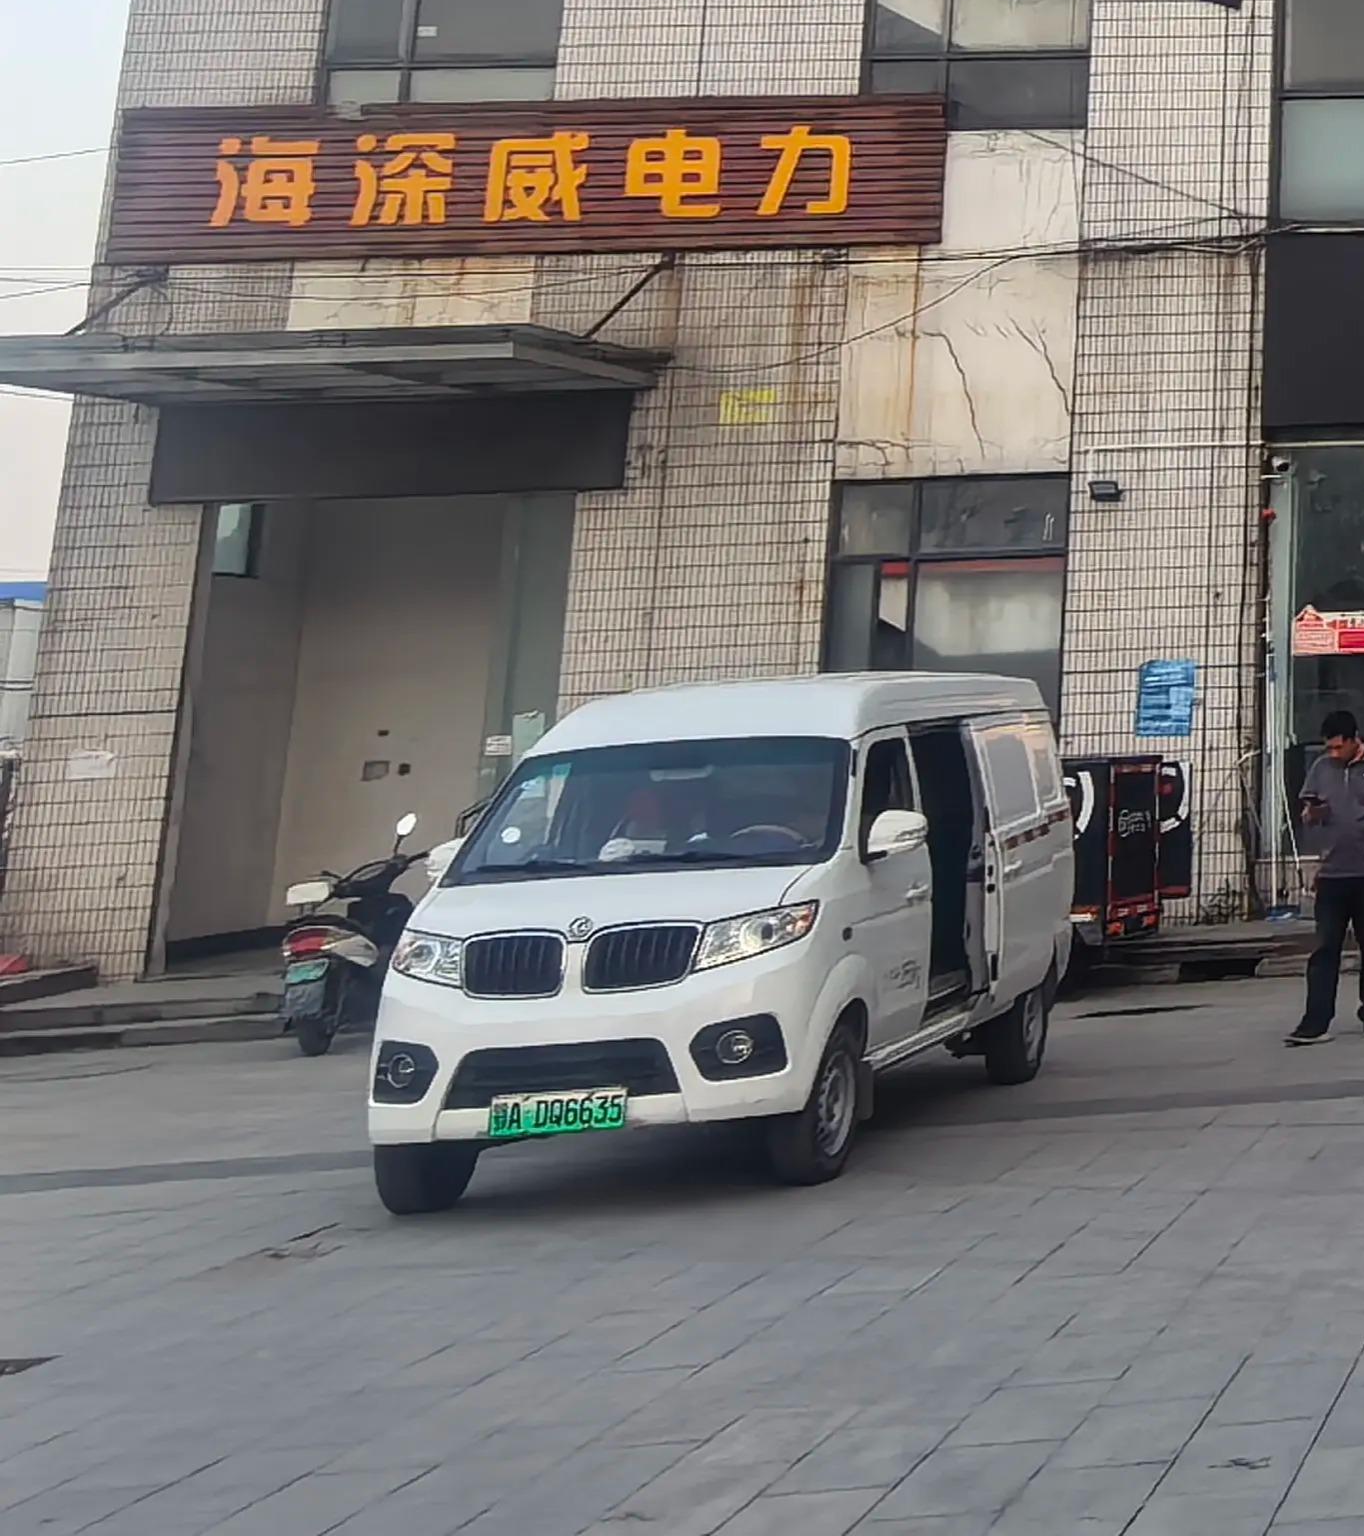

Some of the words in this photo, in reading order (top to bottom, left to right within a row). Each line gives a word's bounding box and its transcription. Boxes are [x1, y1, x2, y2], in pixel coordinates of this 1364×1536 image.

[209, 126, 855, 228] 海深威电力
